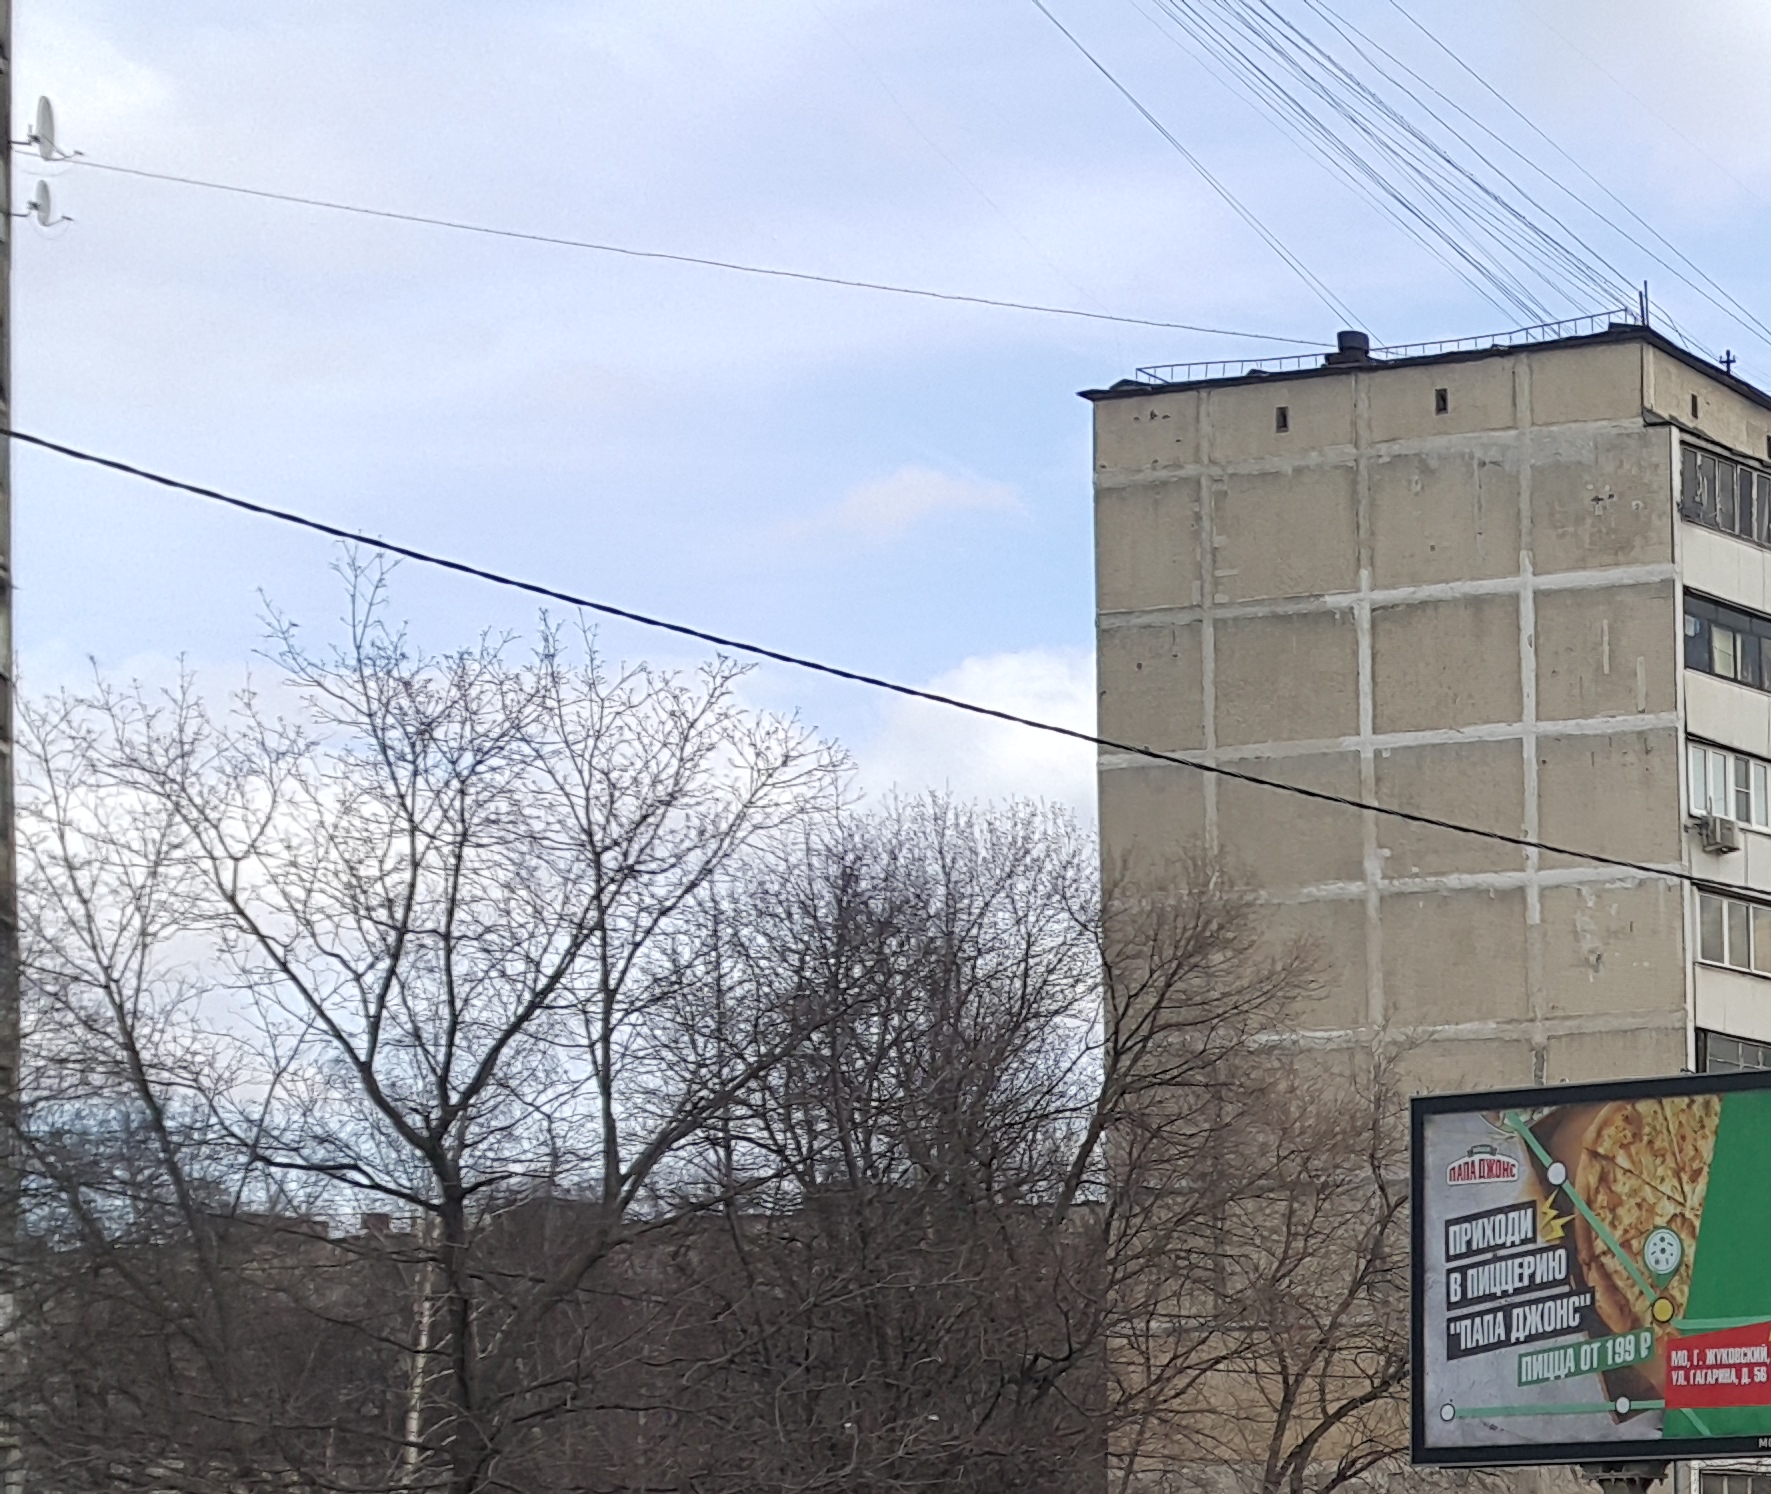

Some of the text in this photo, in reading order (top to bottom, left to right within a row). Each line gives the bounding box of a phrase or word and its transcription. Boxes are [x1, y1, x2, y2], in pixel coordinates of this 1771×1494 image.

[1449, 1158, 1516, 1182] ПАПА ДЖОНС
[1448, 1207, 1534, 1256] ПРИХОДИ
[1450, 1248, 1567, 1303] В ПИЦЦЕРИЮ
[1450, 1293, 1592, 1350] "ПАПА ДЖОНС"
[1521, 1347, 1576, 1383] ПИЦЦА
[1580, 1341, 1602, 1371] ОТ
[1605, 1334, 1636, 1366] 199
[1671, 1343, 1771, 1368] МО, Г. ЖУКОВСКИЙ,
[1671, 1370, 1688, 1386] УЛ.
[1690, 1367, 1739, 1385] ГАГАРИНА,
